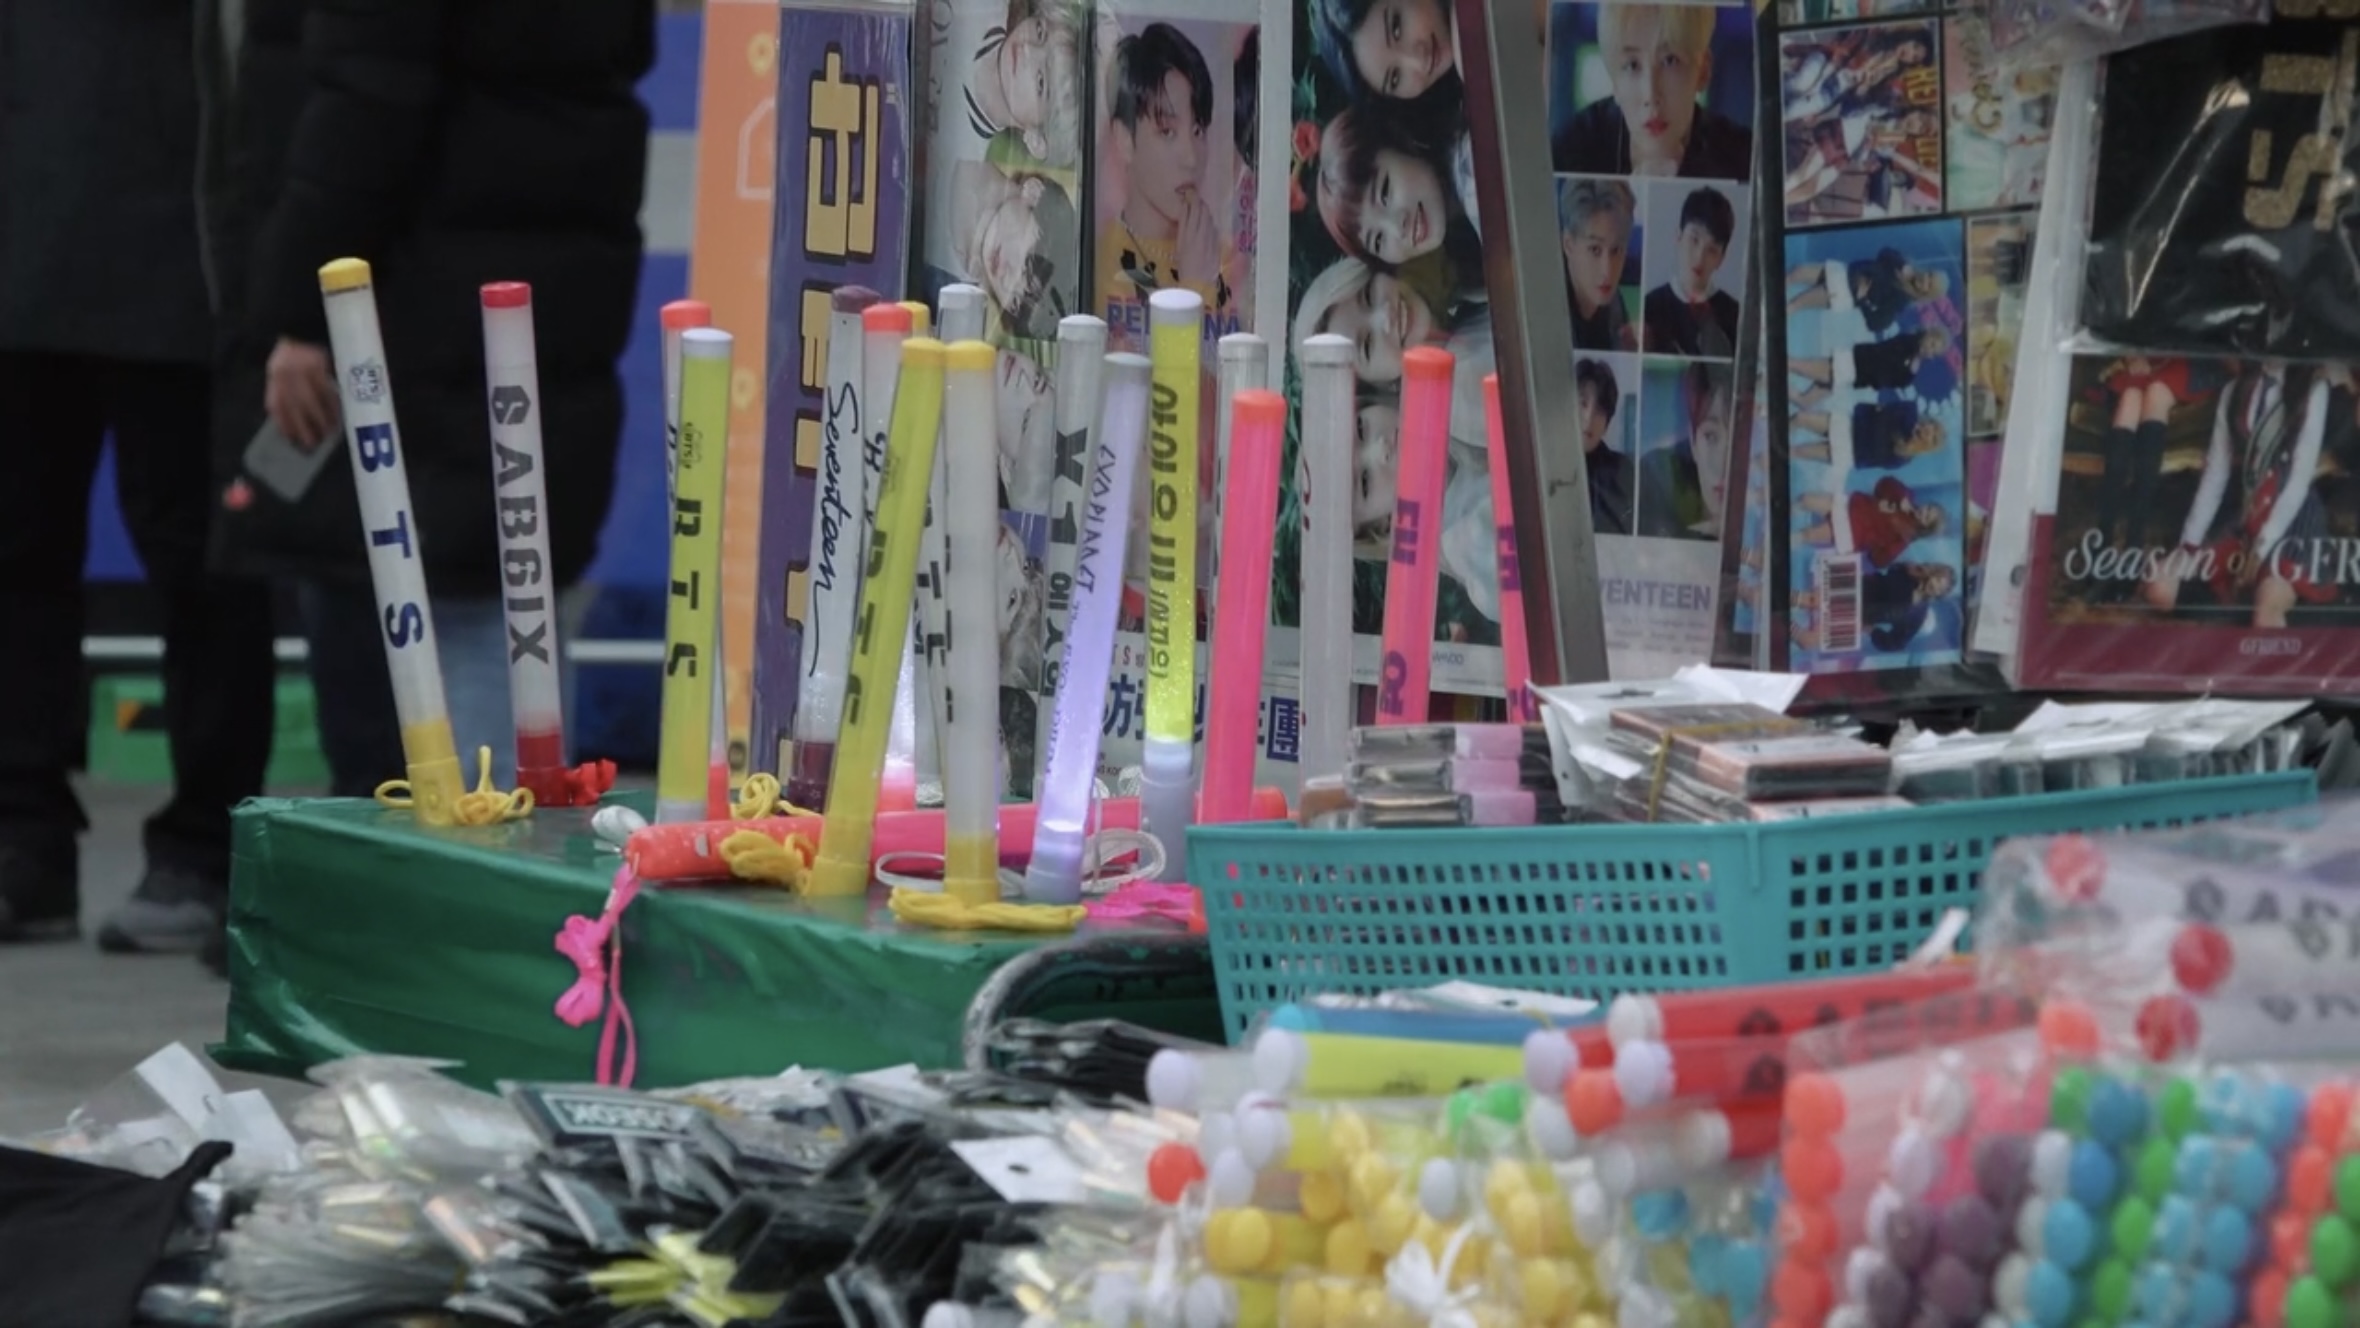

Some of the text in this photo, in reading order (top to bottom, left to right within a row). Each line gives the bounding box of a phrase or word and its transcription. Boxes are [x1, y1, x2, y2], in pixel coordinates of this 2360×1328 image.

[1107, 306, 1240, 340] PENA
[354, 422, 424, 650] BTS
[495, 439, 550, 665] AB6IX
[809, 381, 859, 678] Seventeen
[2064, 528, 2219, 582] Season
